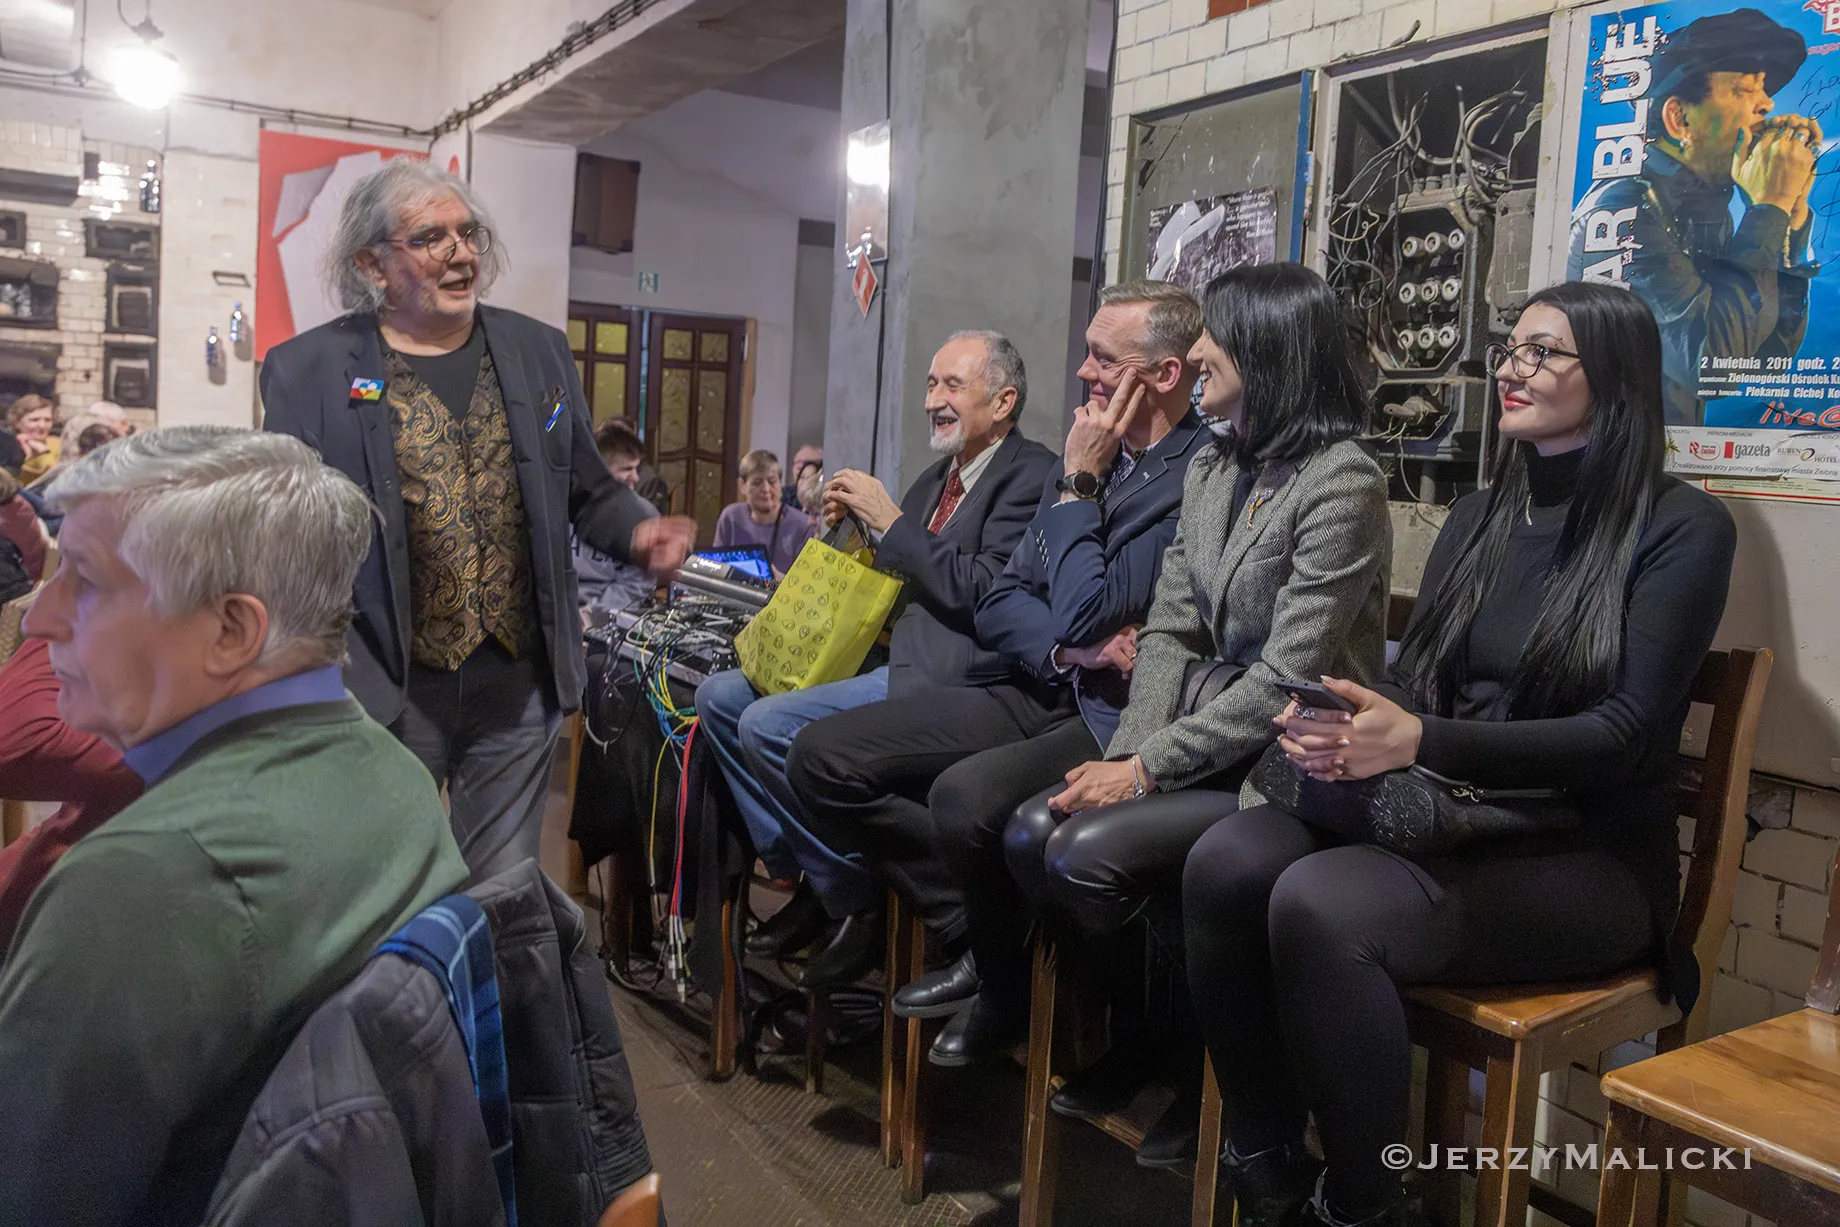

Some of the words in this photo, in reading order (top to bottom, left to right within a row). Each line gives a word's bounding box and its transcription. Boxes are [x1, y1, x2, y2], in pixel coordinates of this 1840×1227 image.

[1592, 15, 1658, 180] BLUE
[1582, 206, 1643, 291] AR
[1700, 356, 1709, 369] 2
[1712, 356, 1761, 369] kwietnia
[1766, 356, 1793, 370] 2011
[1797, 357, 1826, 371] godz.
[1728, 372, 1790, 384] Zielonogórski
[1792, 373, 1829, 384] Ośrodek
[1745, 386, 1790, 397] Piekarnia
[1793, 387, 1825, 399] Cichej
[1735, 443, 1771, 459] gazeta
